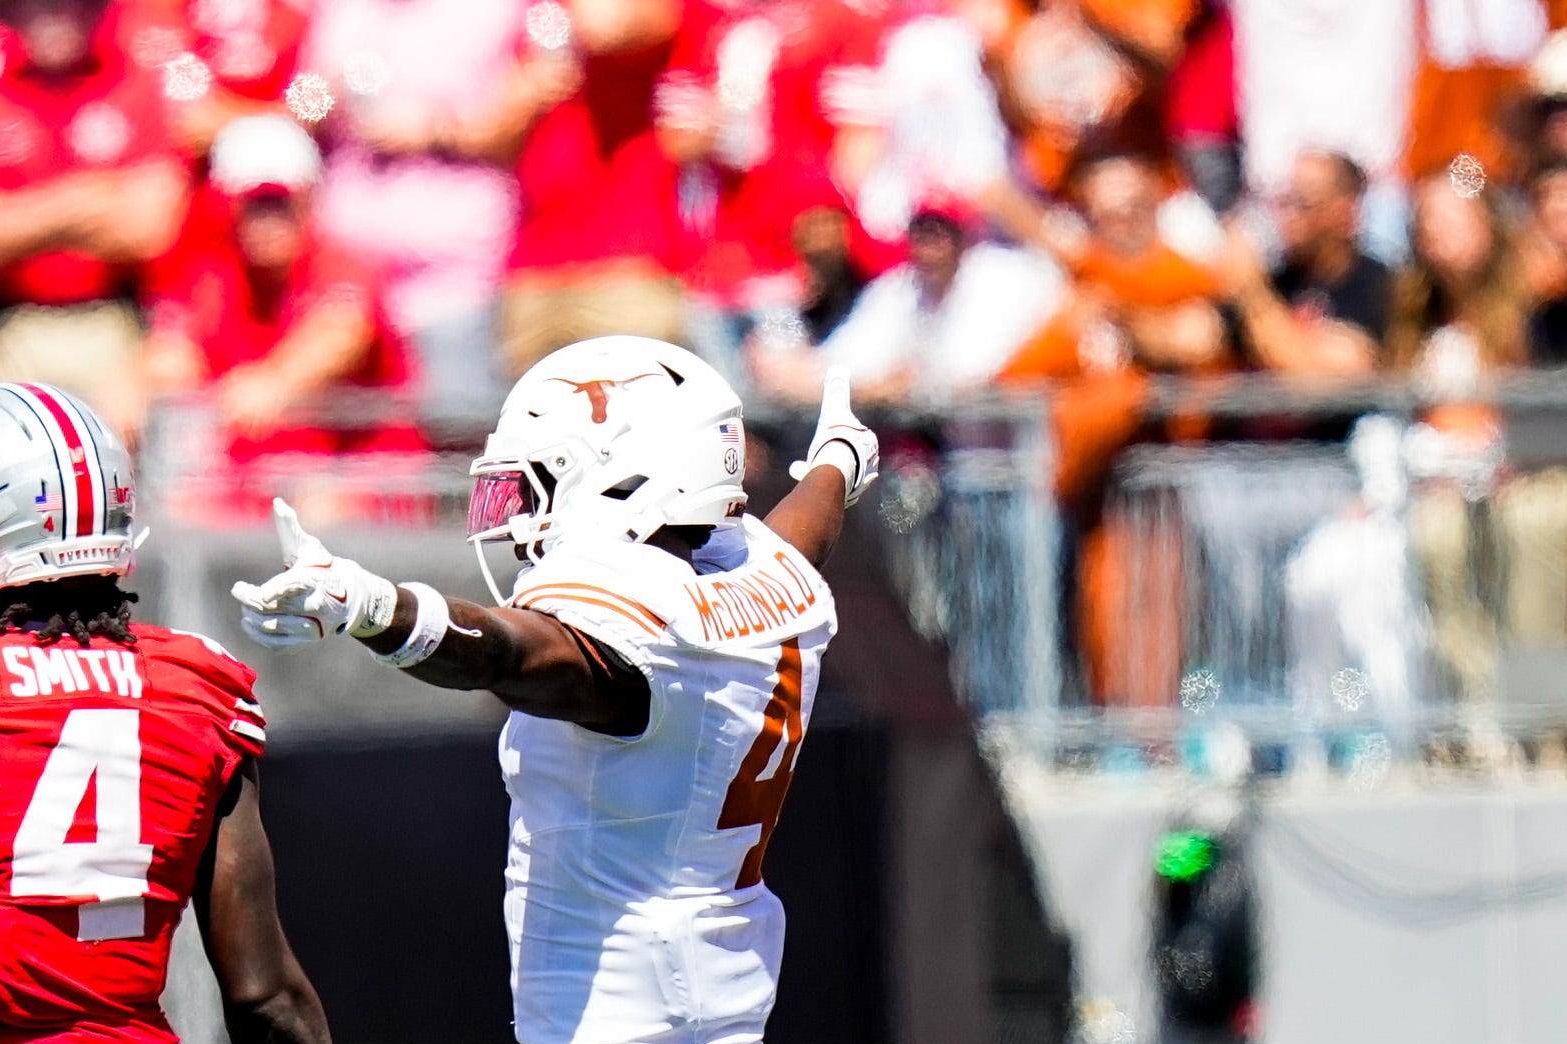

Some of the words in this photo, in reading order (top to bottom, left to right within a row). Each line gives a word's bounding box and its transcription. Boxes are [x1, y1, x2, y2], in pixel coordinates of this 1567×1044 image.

[1, 645, 143, 699] SMITH
[683, 550, 816, 642] McDONALD
[10, 707, 155, 942] 4
[716, 636, 804, 890] 4
